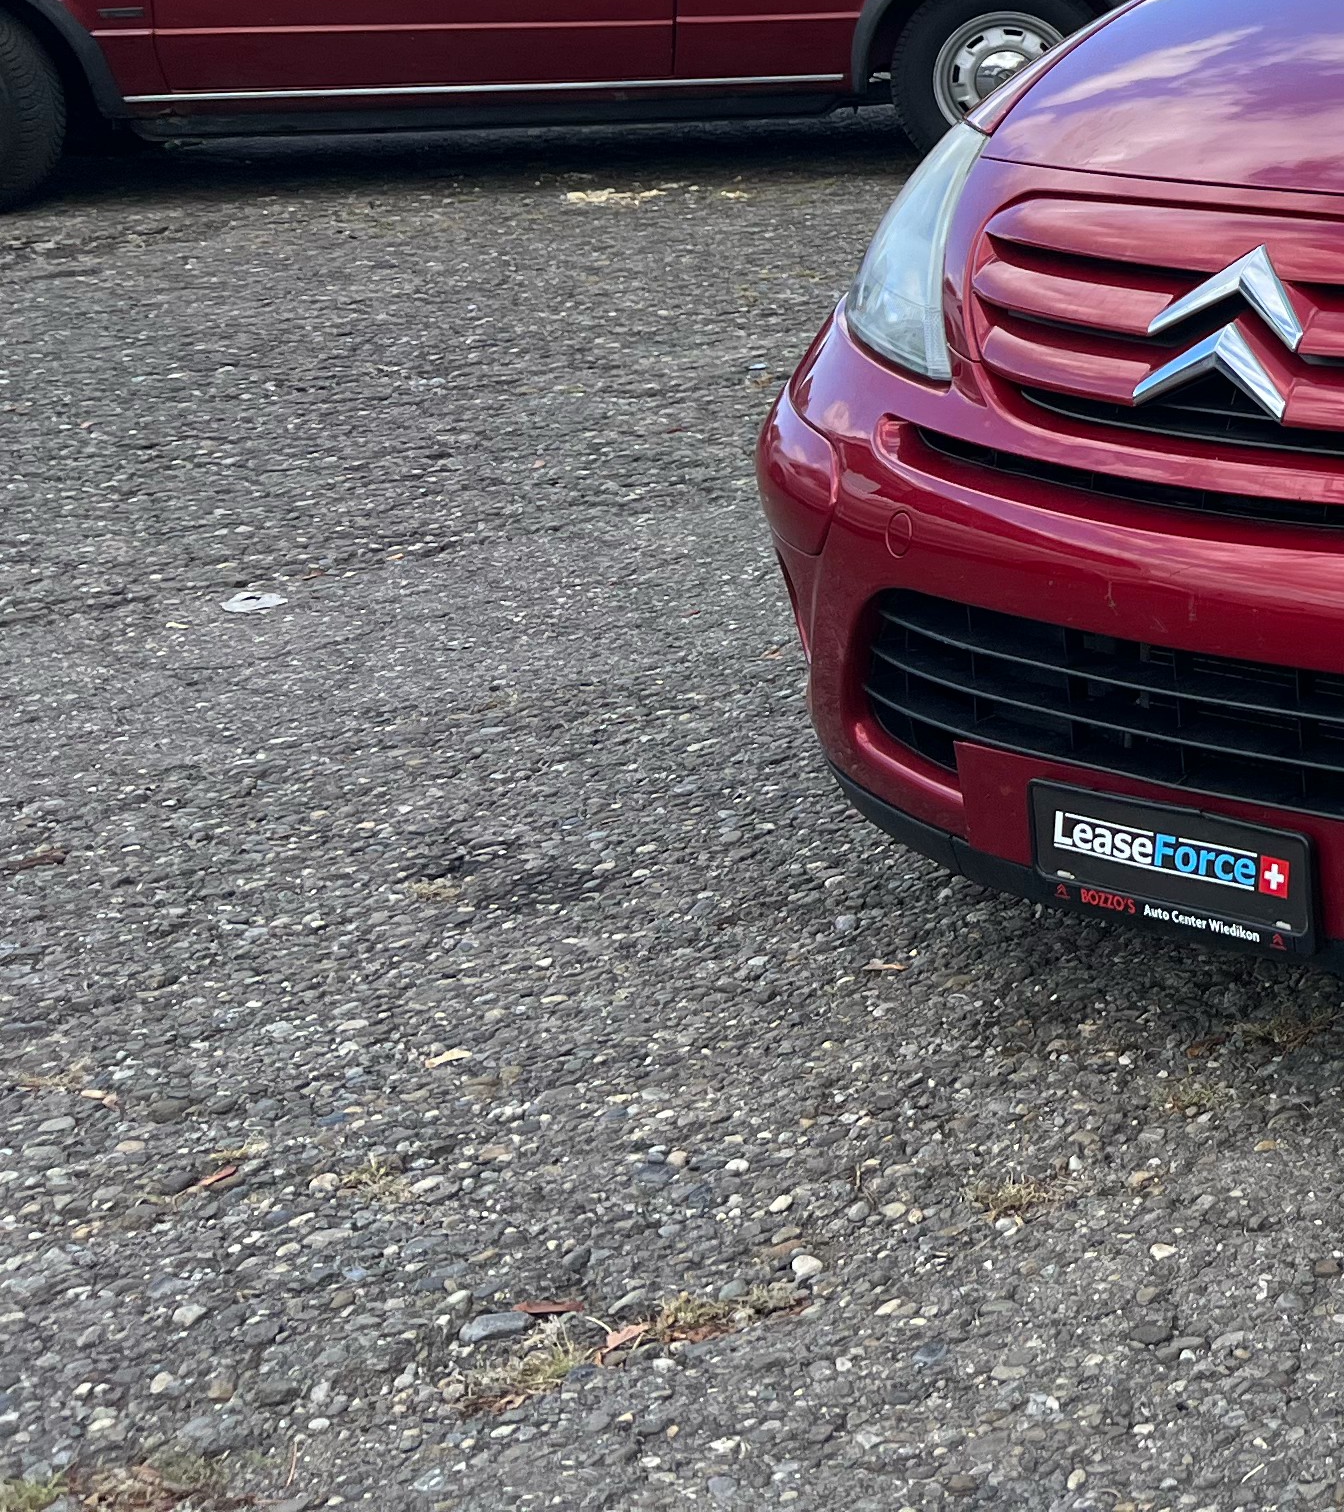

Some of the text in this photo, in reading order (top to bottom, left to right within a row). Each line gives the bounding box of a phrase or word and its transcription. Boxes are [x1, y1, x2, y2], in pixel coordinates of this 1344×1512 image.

[1053, 810, 1257, 886] LeaseForce
[1080, 888, 1260, 943] BOZZO'S Auto Center Wiedikon
